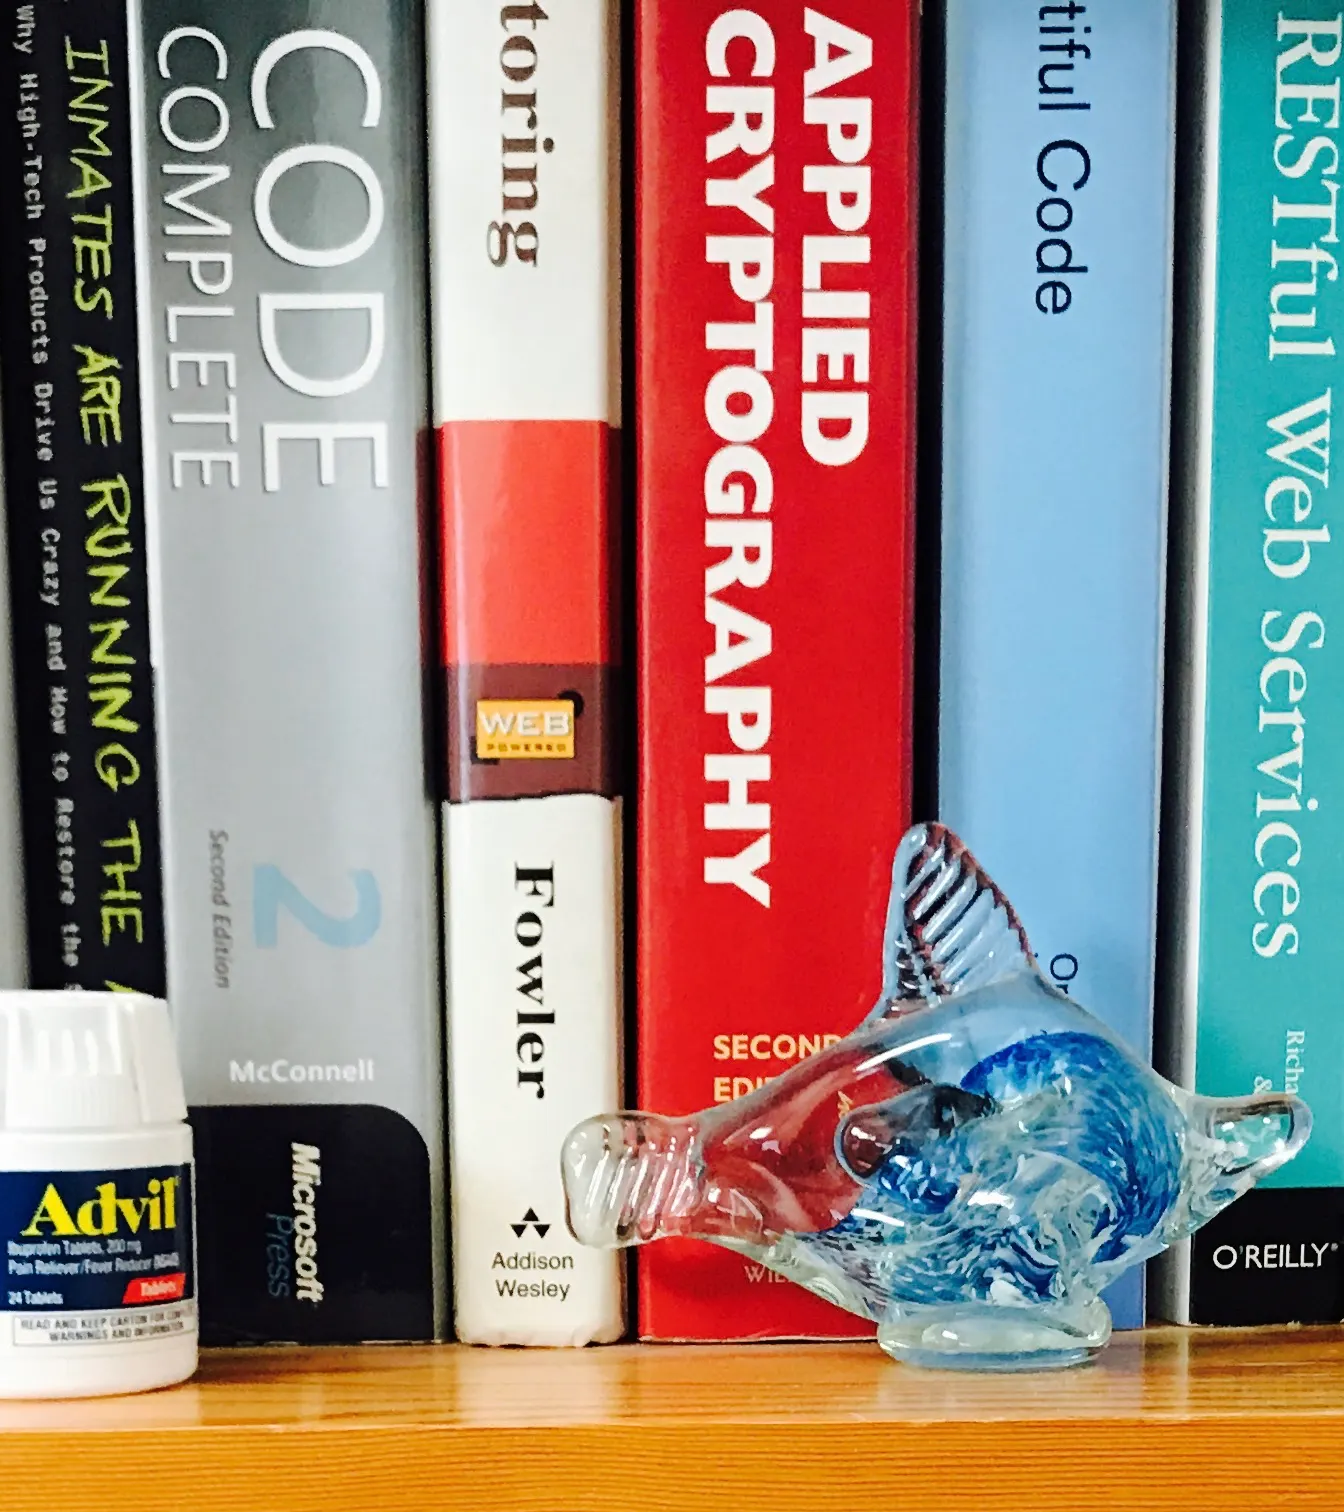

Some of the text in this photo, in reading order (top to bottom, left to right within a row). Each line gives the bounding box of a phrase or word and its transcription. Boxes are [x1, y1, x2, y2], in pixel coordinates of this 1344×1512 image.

[14, 5, 34, 55] Why
[18, 72, 44, 220] High-Tech
[486, 0, 555, 267] toring
[1035, 3, 1091, 315] tiful Code
[157, 25, 241, 492] COMPLETE
[250, 29, 389, 493] CODE
[802, 8, 873, 468] APPLIED
[27, 239, 48, 365] Products
[34, 383, 52, 462] Drive
[703, 8, 776, 908] CRYPTOGRAPHY
[65, 37, 144, 948] INMATES ARE RUNNING THE
[1251, 12, 1344, 959] RESTful Web Services
[41, 527, 62, 607] Crazy
[46, 624, 64, 671] and
[50, 686, 68, 735] How
[479, 711, 571, 738] WEB
[53, 751, 70, 782] to
[56, 798, 77, 906] Restore
[63, 924, 80, 969] the
[514, 861, 557, 1100] Fowler
[229, 1059, 374, 1085] McConnell
[20, 1177, 178, 1236] Advil
[291, 1142, 323, 1303] Microsoft
[492, 1251, 574, 1271] Addison
[495, 1278, 571, 1302] Wesley
[1213, 1245, 1330, 1269] O'REILLY
